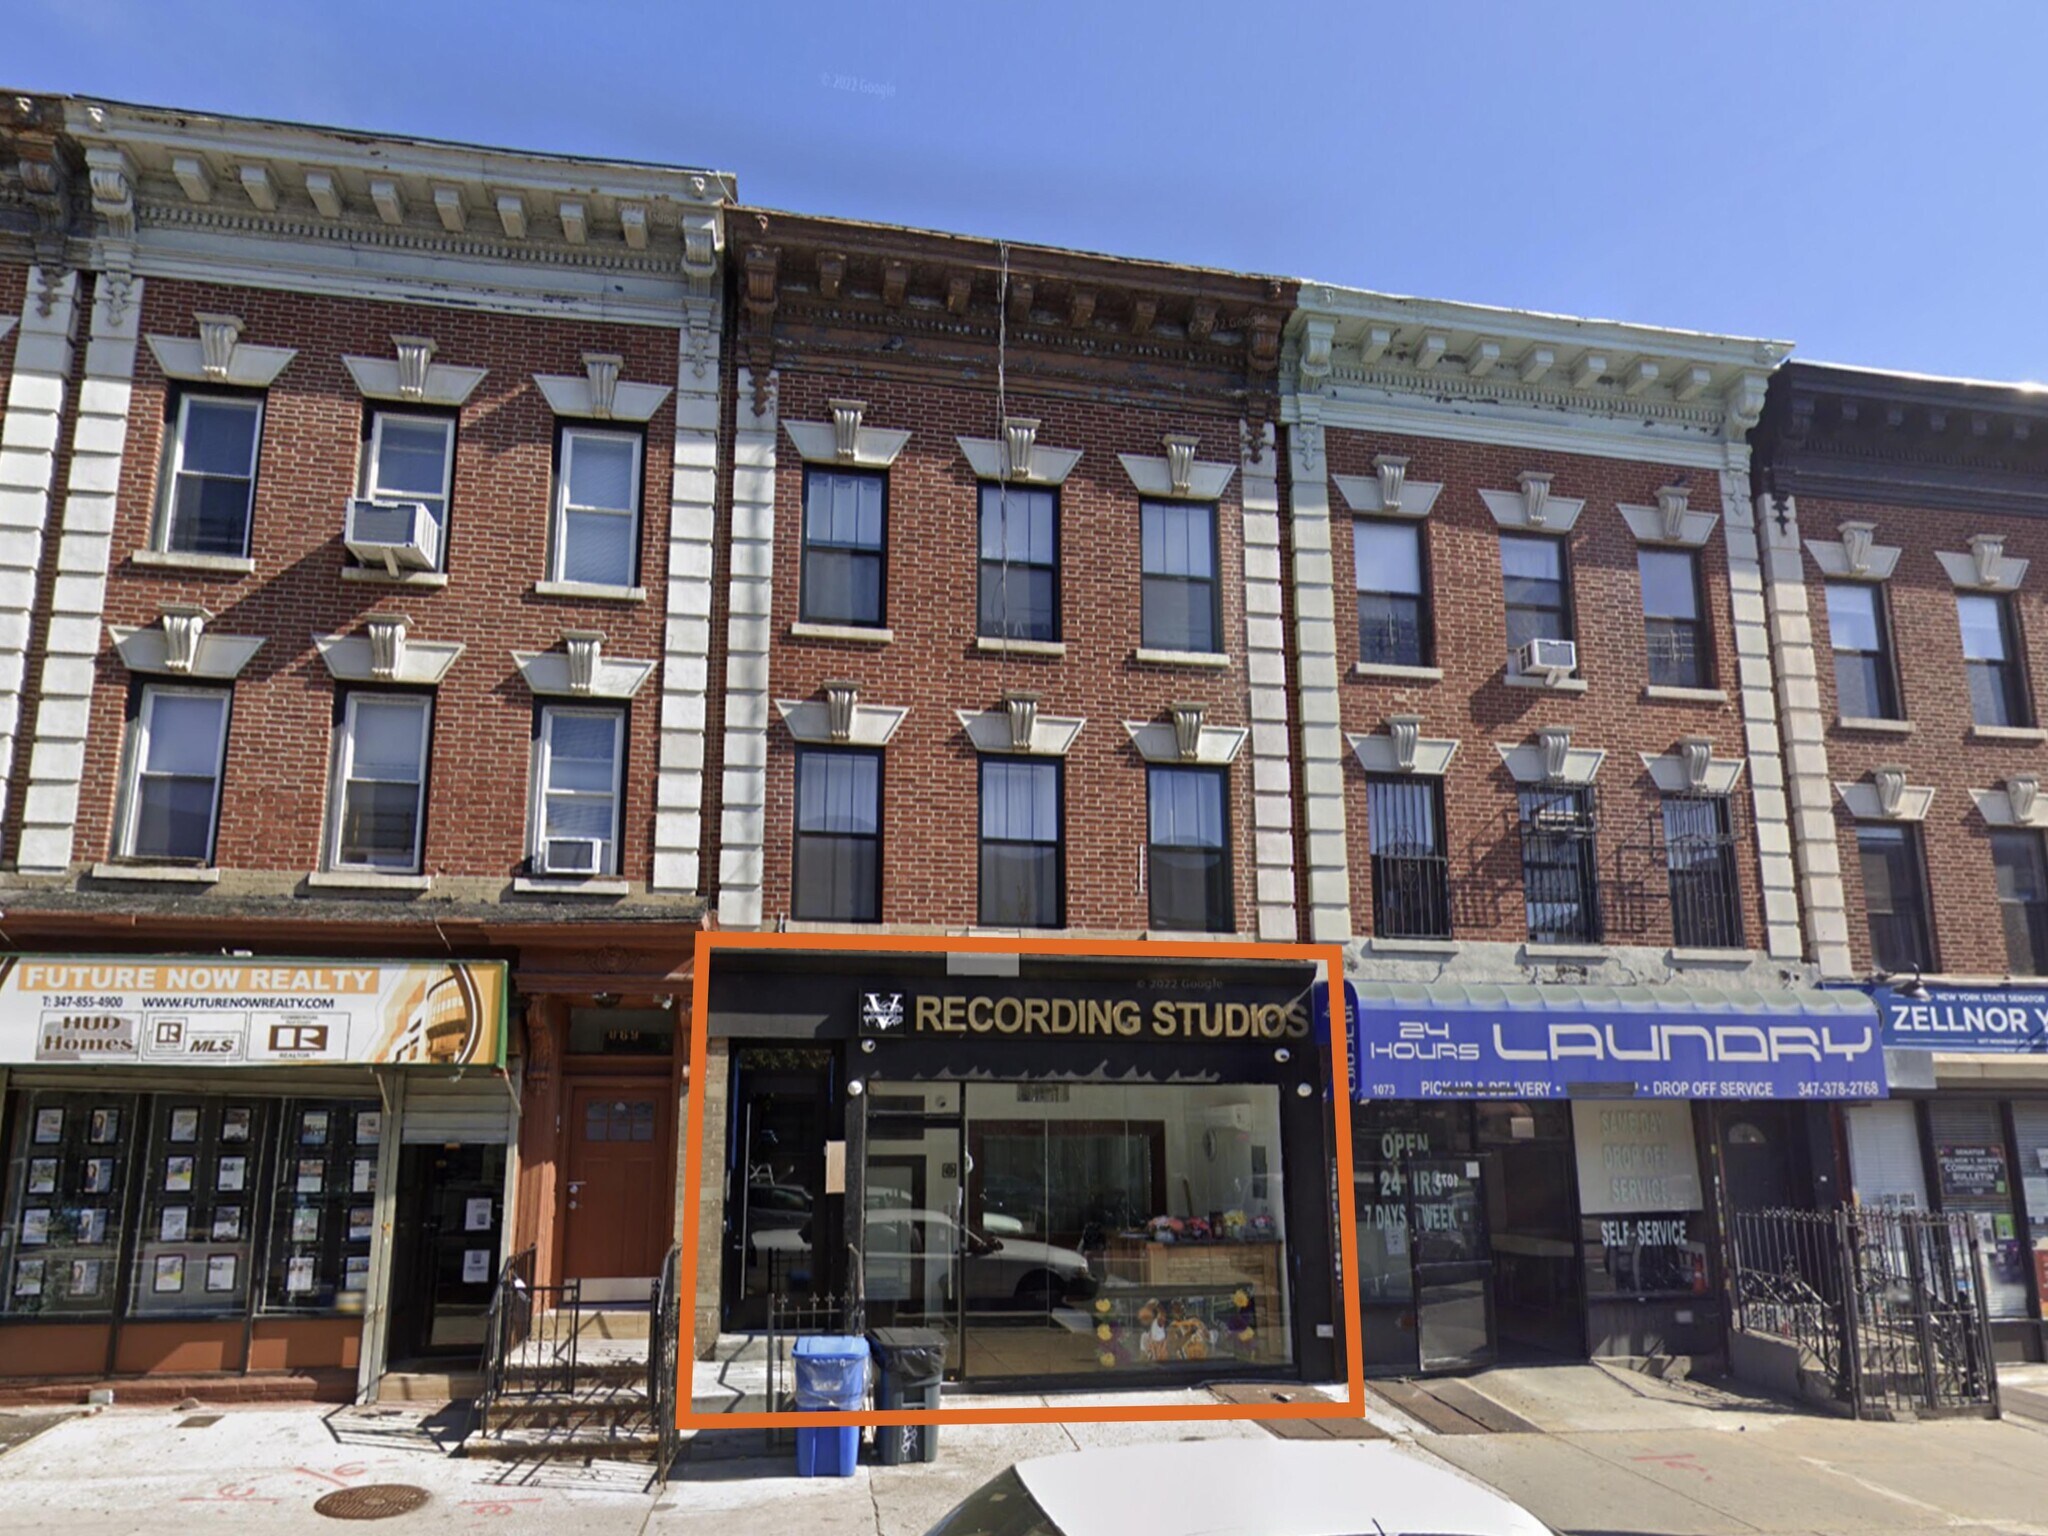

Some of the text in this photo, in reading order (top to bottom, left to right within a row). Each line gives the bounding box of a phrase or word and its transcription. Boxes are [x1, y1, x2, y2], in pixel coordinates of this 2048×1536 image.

[26, 966, 373, 992] FUTURE NOW REALTY
[42, 995, 124, 1008] T: 347-855-4900
[142, 997, 335, 1009] WWW.FUTURENOWREALTY.COM
[1936, 991, 2045, 1004] NEW YORK STATE SENATOR
[63, 1016, 121, 1030] HUD
[915, 995, 1309, 1038] RECORDING STUDIOS
[1890, 1005, 2029, 1033] ZELLNOR
[1399, 1021, 1450, 1039] 24
[44, 1035, 133, 1051] Homes
[190, 1040, 234, 1053] MLS
[1493, 1023, 1873, 1062] LAUNDRY
[1370, 1042, 1480, 1061] HOURS
[1372, 1084, 1396, 1096] 1073
[1652, 1081, 1689, 1096] DROP
[1691, 1081, 1718, 1097] OFF
[1719, 1081, 1774, 1097] SERVICE
[1797, 1081, 1880, 1096] 347-378-2768
[1639, 1111, 1664, 1133] DAY
[1603, 1143, 1640, 1169] DROP
[1952, 1172, 1995, 1181] BULLETIN
[1612, 1178, 1669, 1202] SERVICE
[1364, 1204, 1372, 1230] 7
[1375, 1203, 1407, 1230] DAYS
[1421, 1203, 1458, 1229] WEEK
